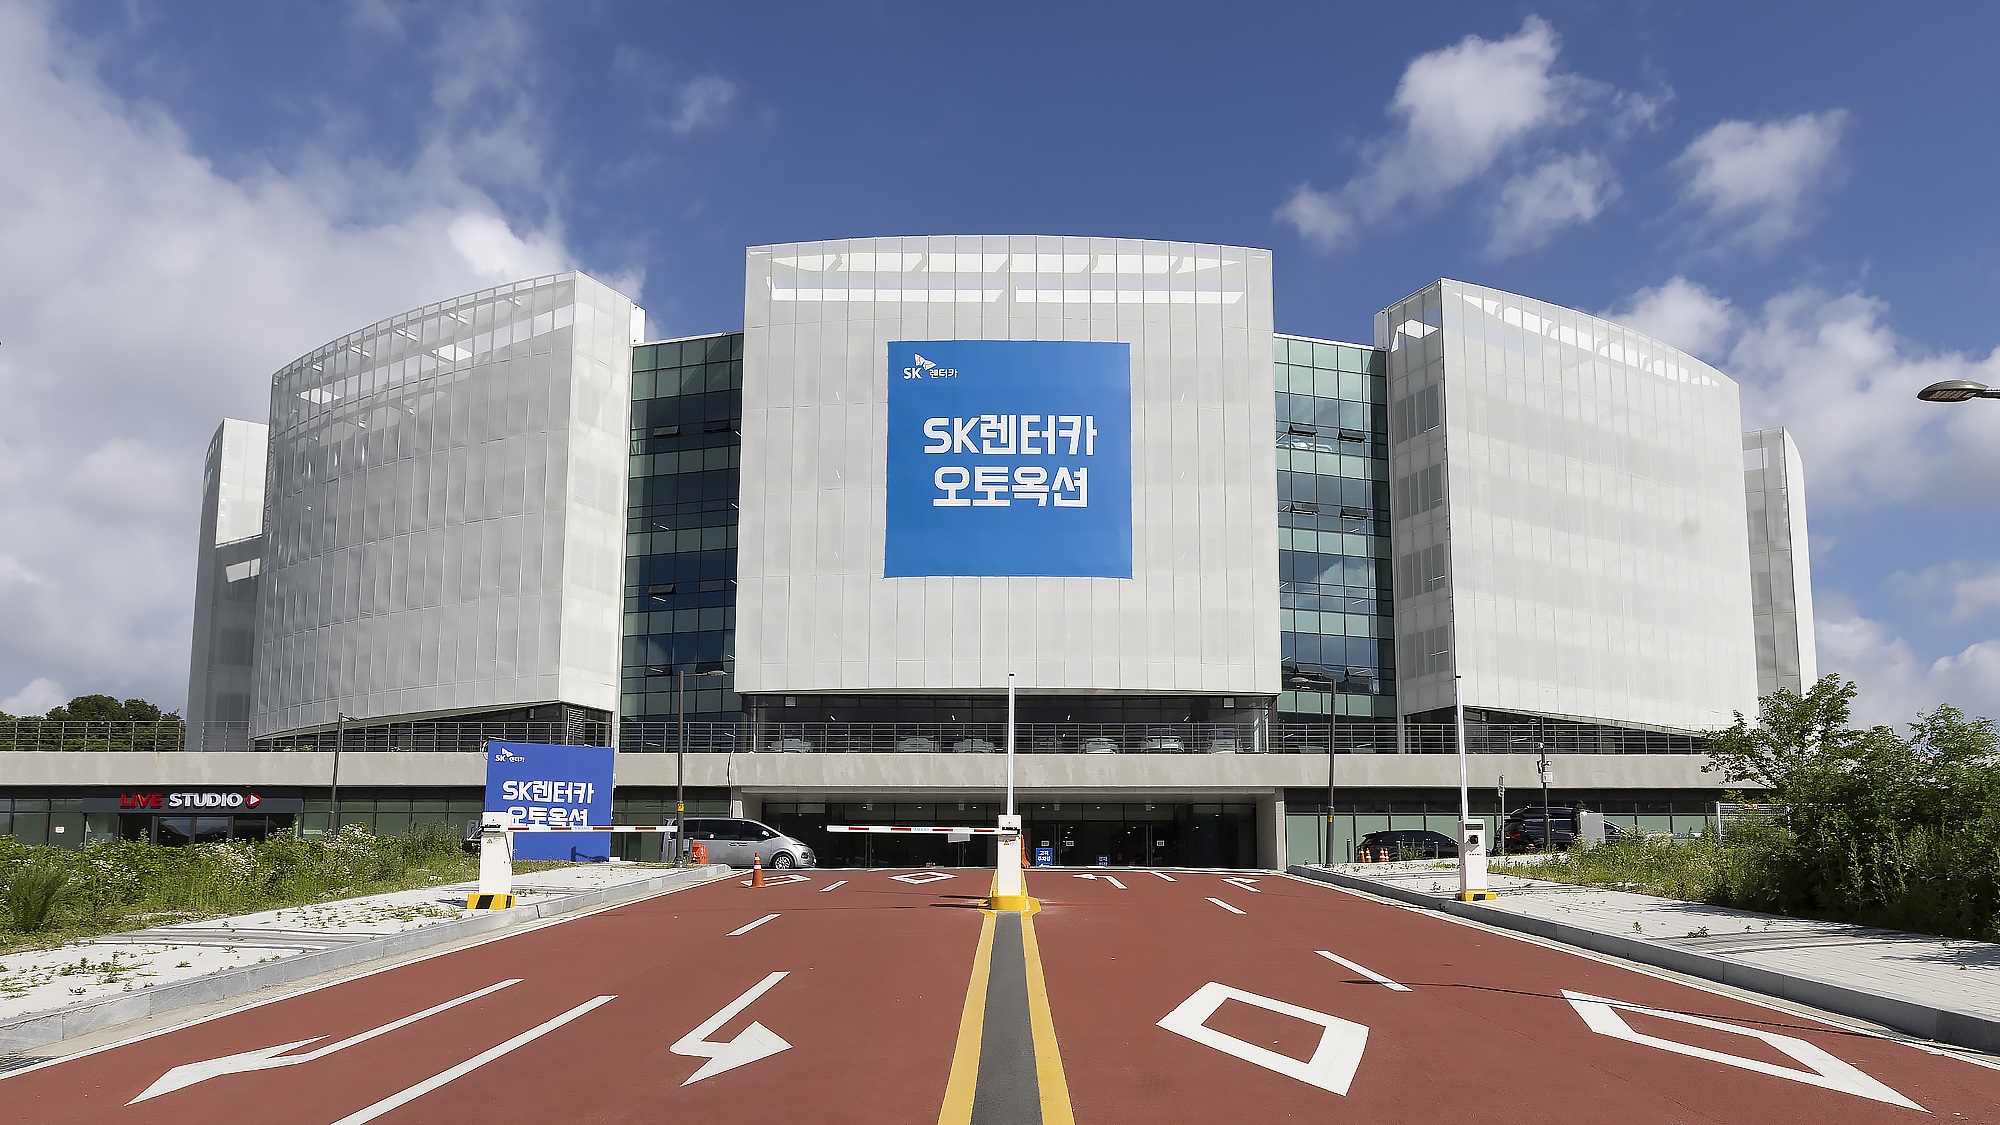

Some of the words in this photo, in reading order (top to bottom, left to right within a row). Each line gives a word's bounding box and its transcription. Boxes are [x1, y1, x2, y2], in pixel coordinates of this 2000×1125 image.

[903, 367, 922, 379] SK
[929, 368, 958, 379] 렌터카
[923, 414, 1098, 456] SK렌터카
[933, 466, 1088, 507] 오토옥션
[120, 793, 164, 807] LIVE
[168, 793, 244, 807] STUDIO
[502, 780, 595, 804] SK렌터카
